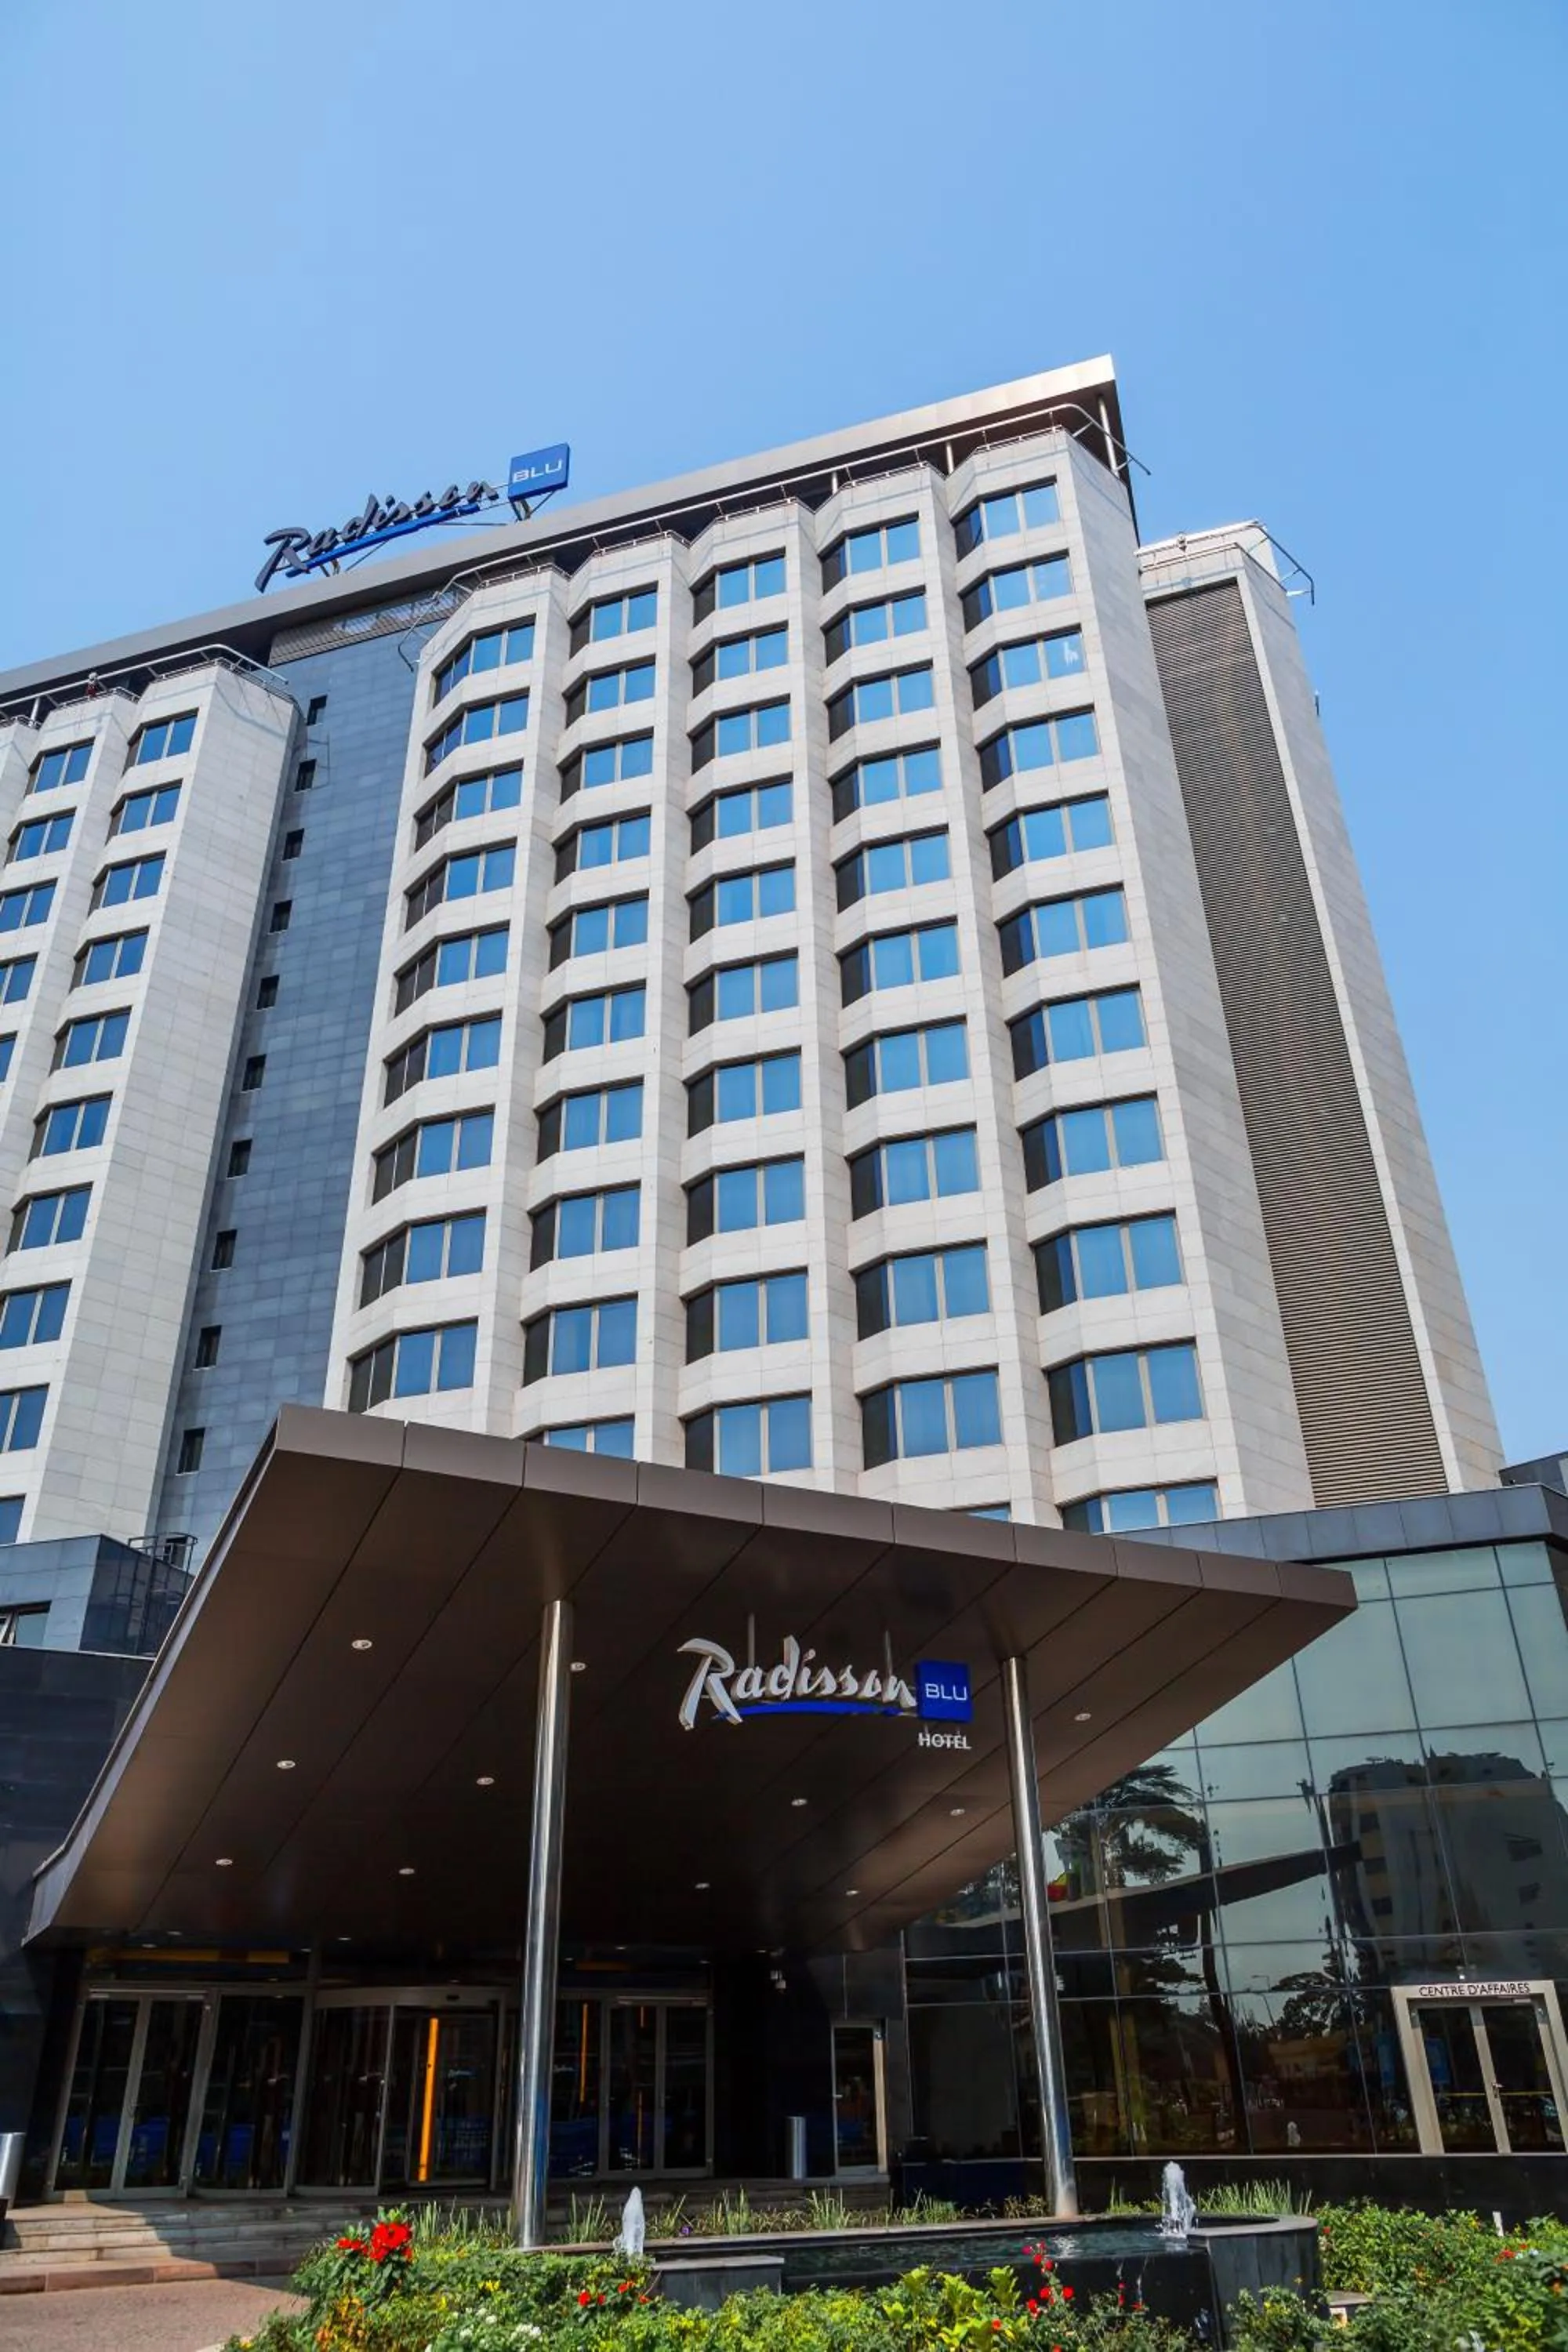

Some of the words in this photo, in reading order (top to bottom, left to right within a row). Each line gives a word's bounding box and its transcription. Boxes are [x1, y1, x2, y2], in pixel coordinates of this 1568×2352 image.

[255, 481, 499, 593] Radisson
[512, 459, 563, 483] BLU
[677, 1635, 917, 1730] Radisson
[925, 1683, 967, 1701] BLU
[918, 1732, 971, 1750] HOTEL
[1419, 1985, 1465, 1997] CENTRE
[1468, 1983, 1531, 1996] D'AFFAIRES
